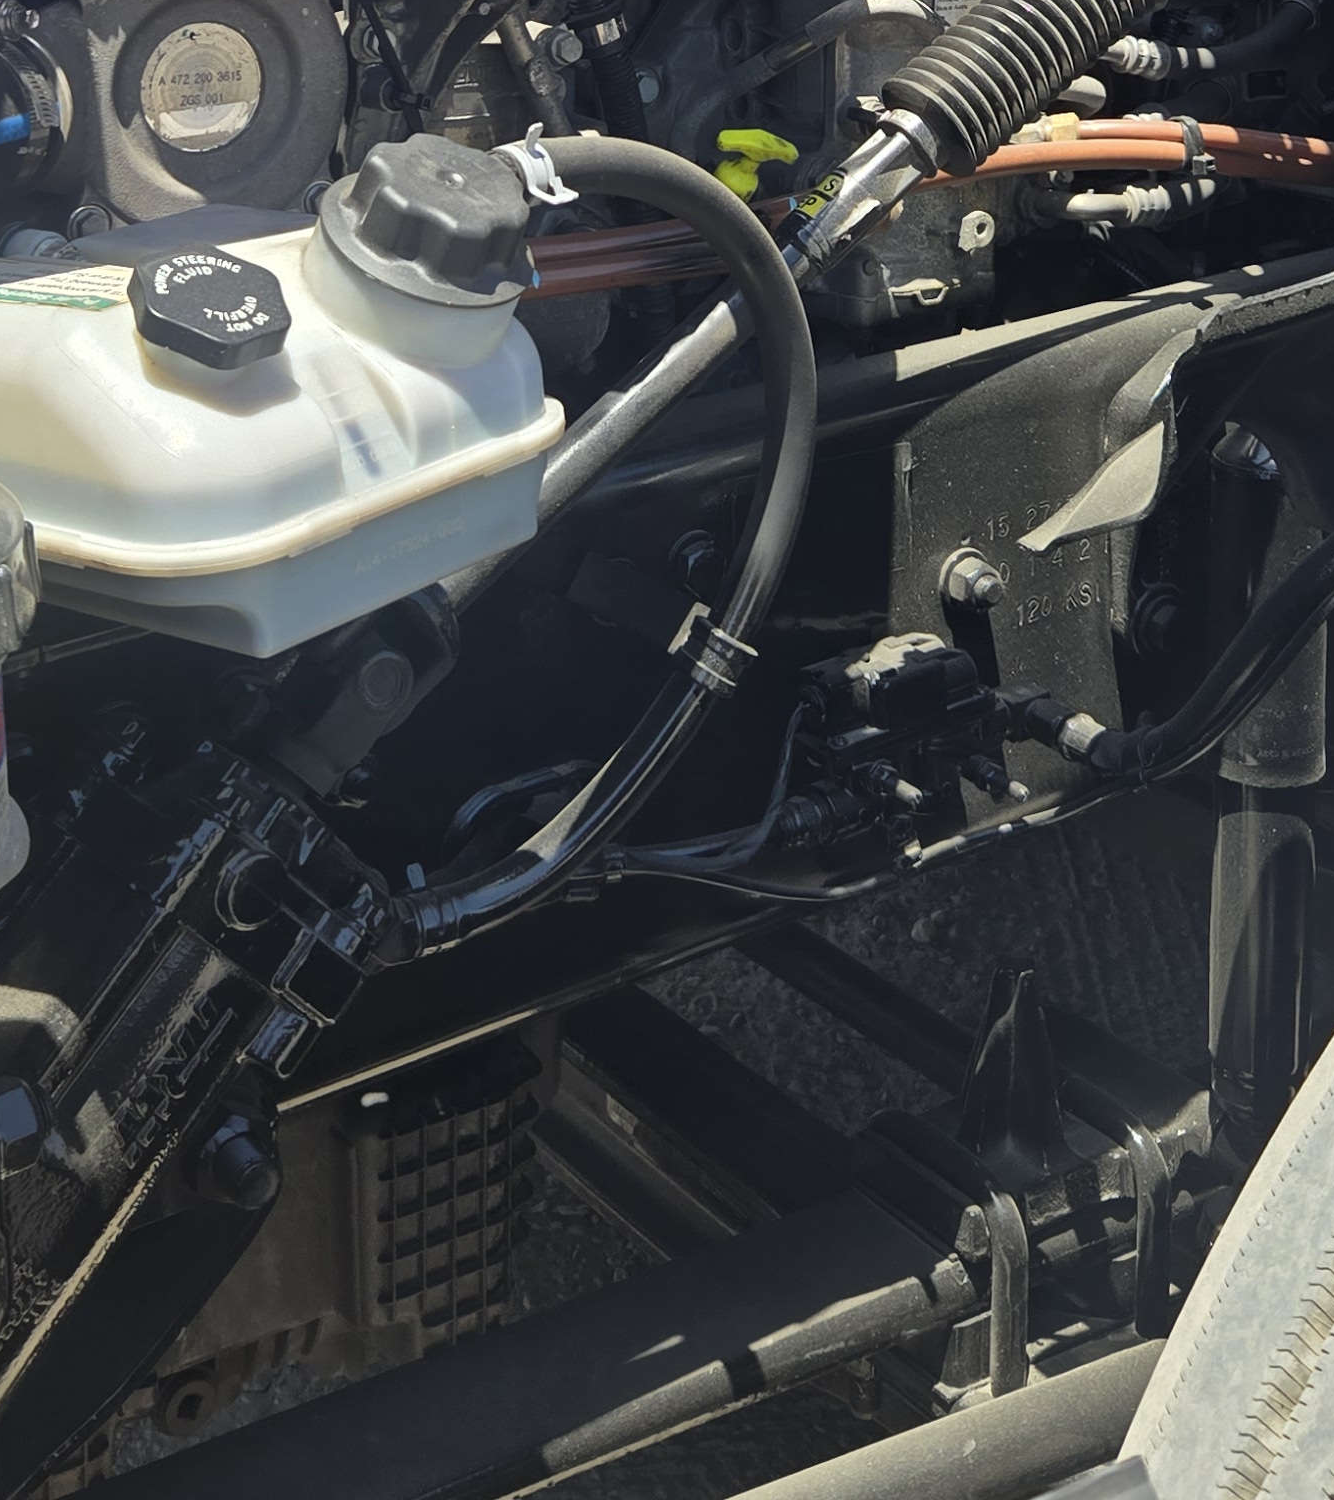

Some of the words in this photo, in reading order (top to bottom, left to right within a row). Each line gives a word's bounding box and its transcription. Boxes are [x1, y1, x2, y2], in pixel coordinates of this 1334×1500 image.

[158, 76, 166, 86] A
[170, 73, 190, 85] 472
[194, 72, 213, 84] 200
[216, 69, 242, 83] 3615
[180, 94, 201, 107] ZGS
[205, 93, 224, 104] 001
[823, 178, 839, 192] S
[154, 263, 174, 294] POWER
[172, 255, 242, 274] STEERING
[172, 266, 213, 284] FLUID
[203, 295, 258, 321] OVERFILL
[226, 321, 254, 332] NOT
[252, 311, 270, 326] DO
[987, 512, 1009, 540] 15
[1016, 594, 1053, 627] 120
[1066, 579, 1101, 611] KSI
